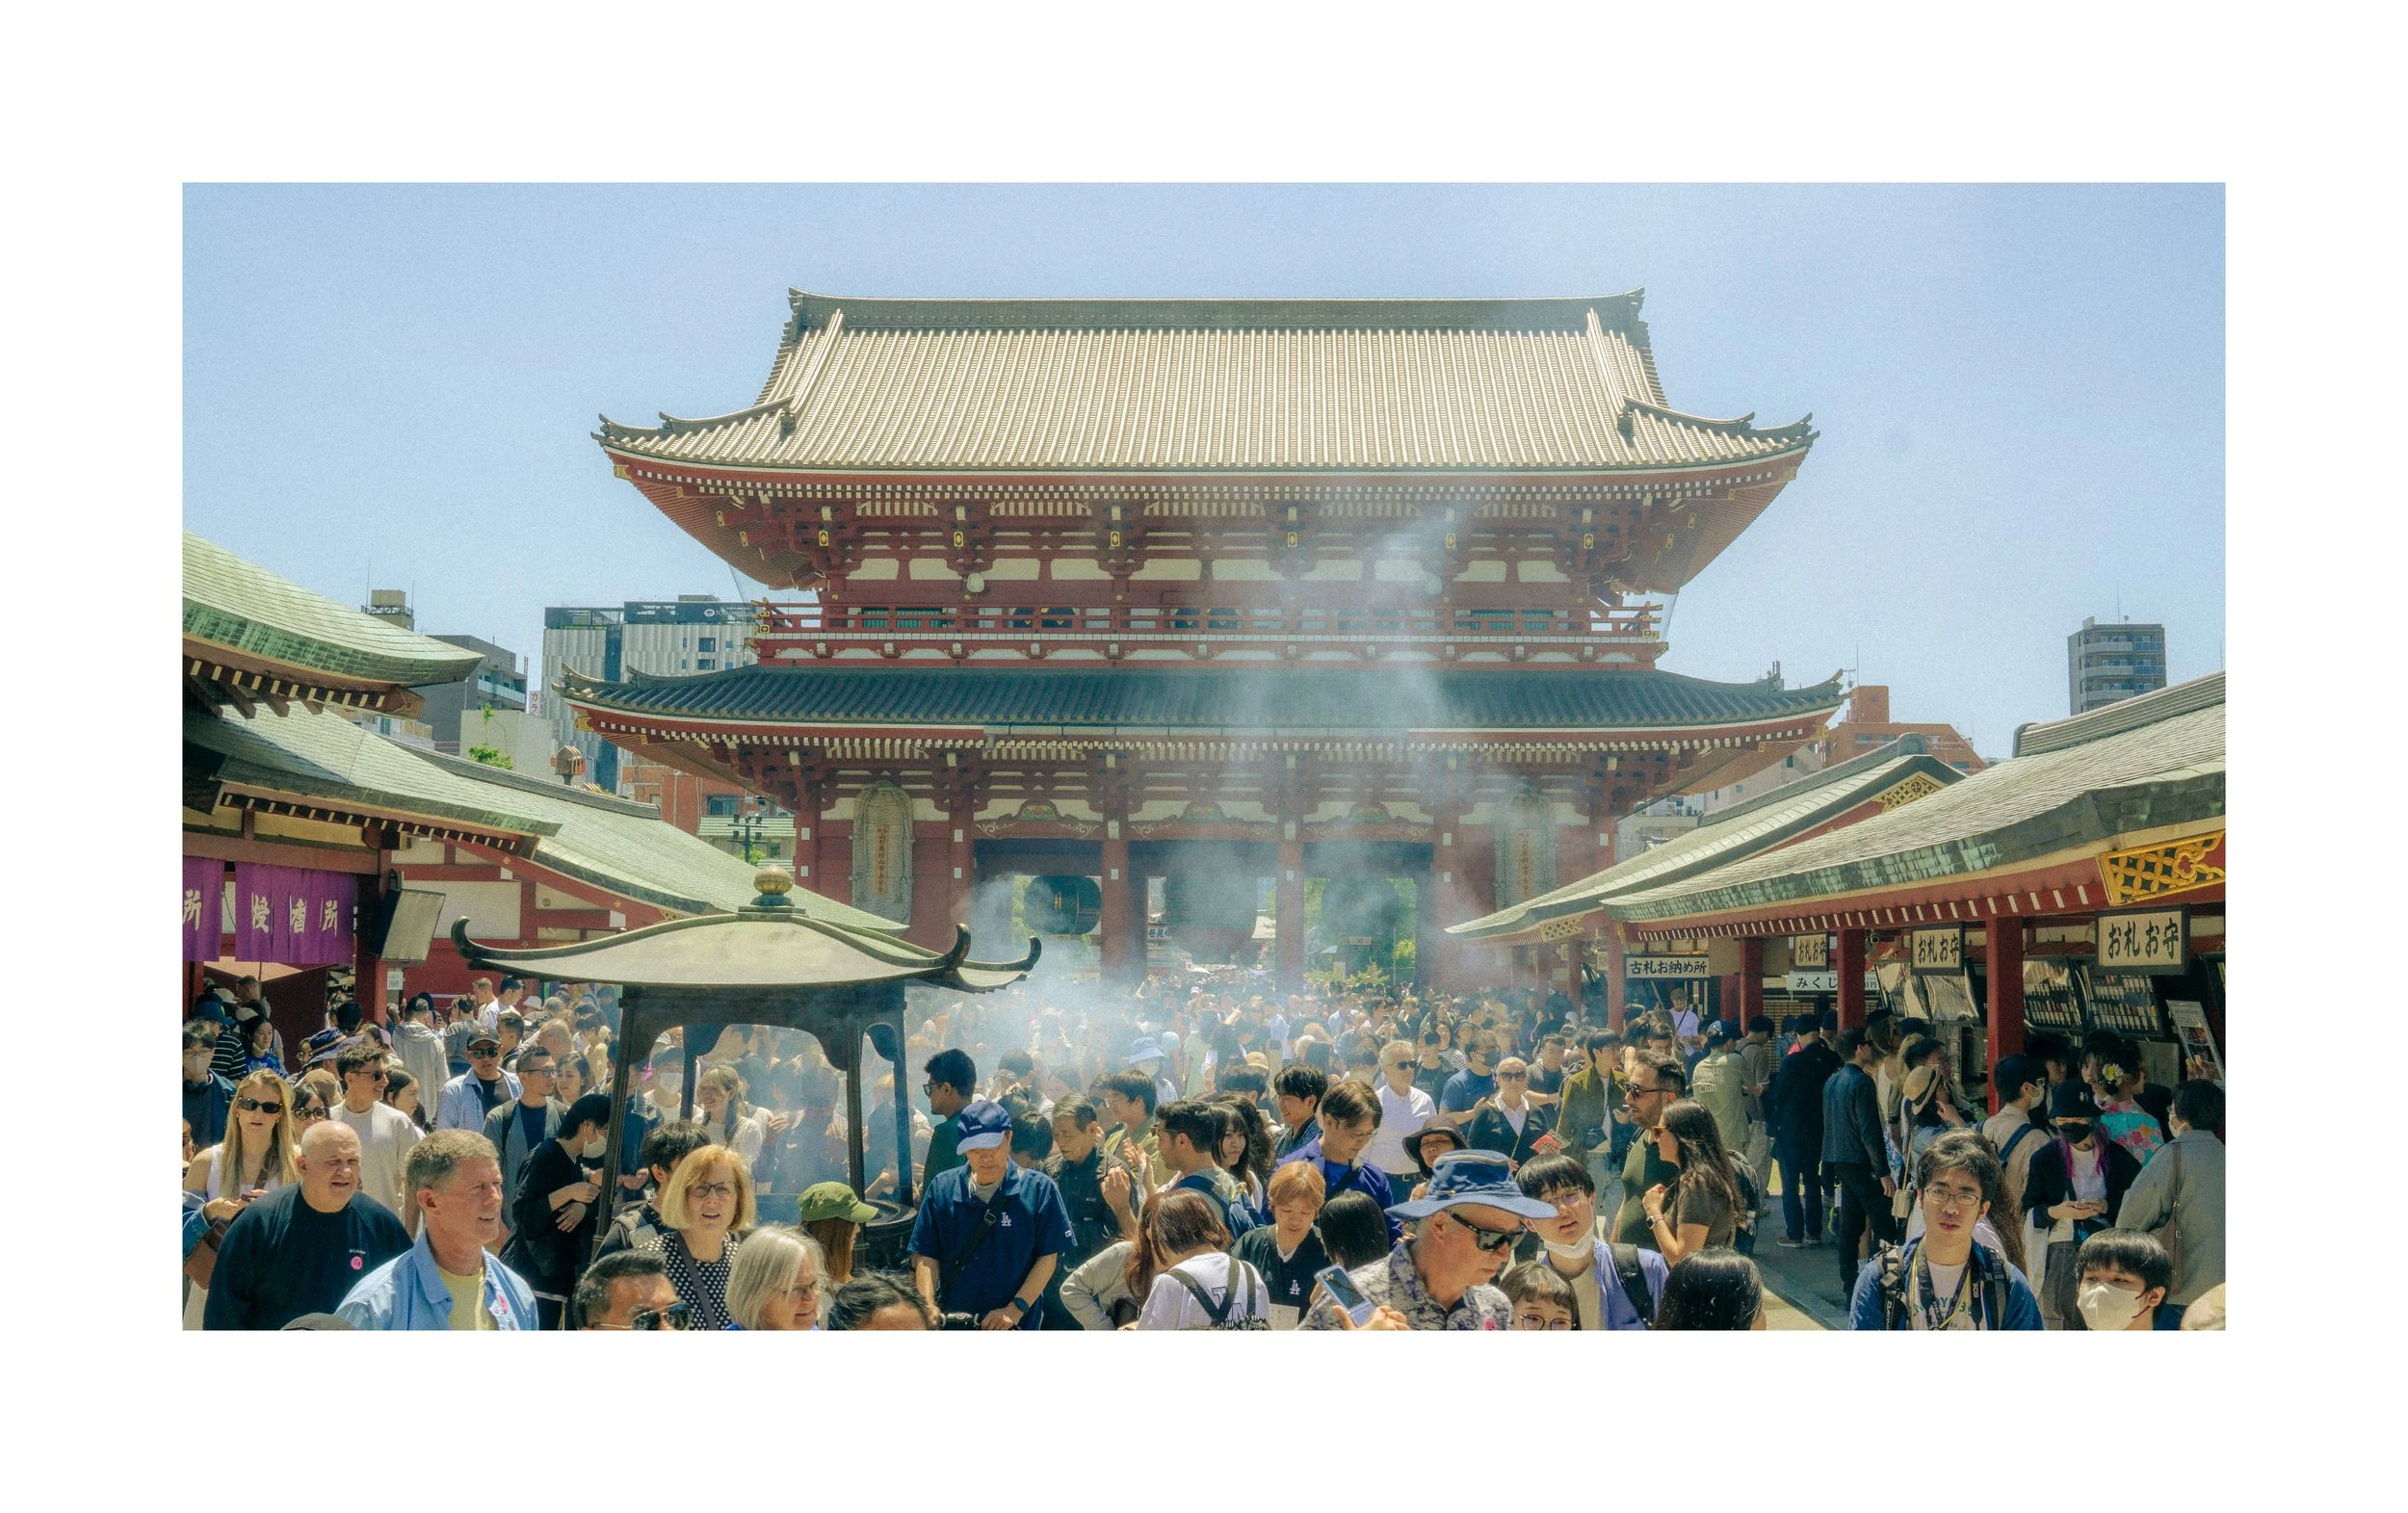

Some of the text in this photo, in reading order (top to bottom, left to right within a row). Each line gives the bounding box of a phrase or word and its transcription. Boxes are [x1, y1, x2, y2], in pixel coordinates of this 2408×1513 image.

[182, 889, 202, 931] 所
[1798, 937, 1826, 963] お札お守
[1918, 931, 1960, 965] お札お守
[2107, 916, 2180, 960] お札お守
[1630, 959, 1708, 975] 古札お納め所
[1001, 1212, 1012, 1227] LA
[1289, 1279, 1301, 1295] LA
